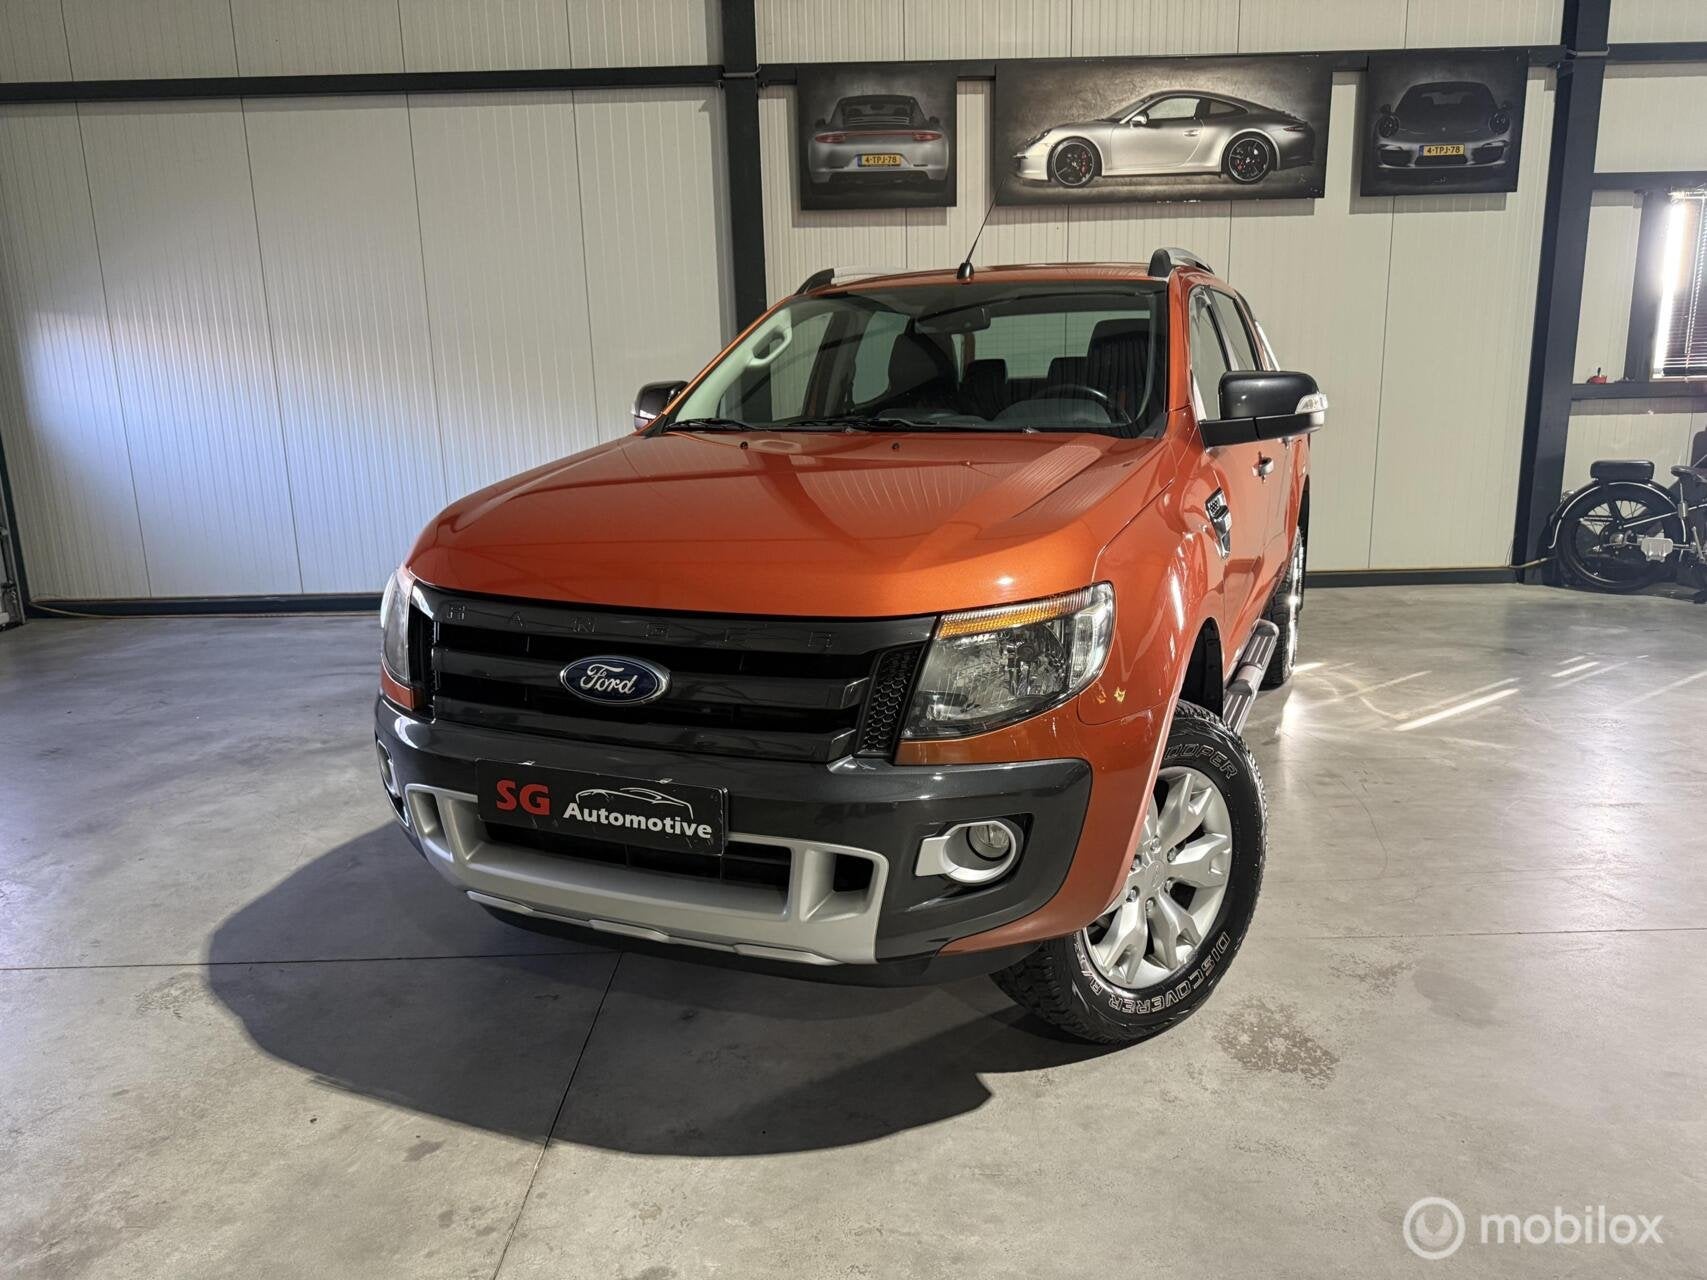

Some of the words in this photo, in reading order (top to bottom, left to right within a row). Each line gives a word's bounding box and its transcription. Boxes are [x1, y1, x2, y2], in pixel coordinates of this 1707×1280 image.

[1426, 145, 1461, 155] 4-TPJ-78
[580, 663, 638, 695] Ford
[1163, 743, 1238, 780] OOPER
[496, 778, 550, 816] SG
[563, 802, 713, 839] Automotive
[1108, 931, 1231, 1015] DISCOVERER
